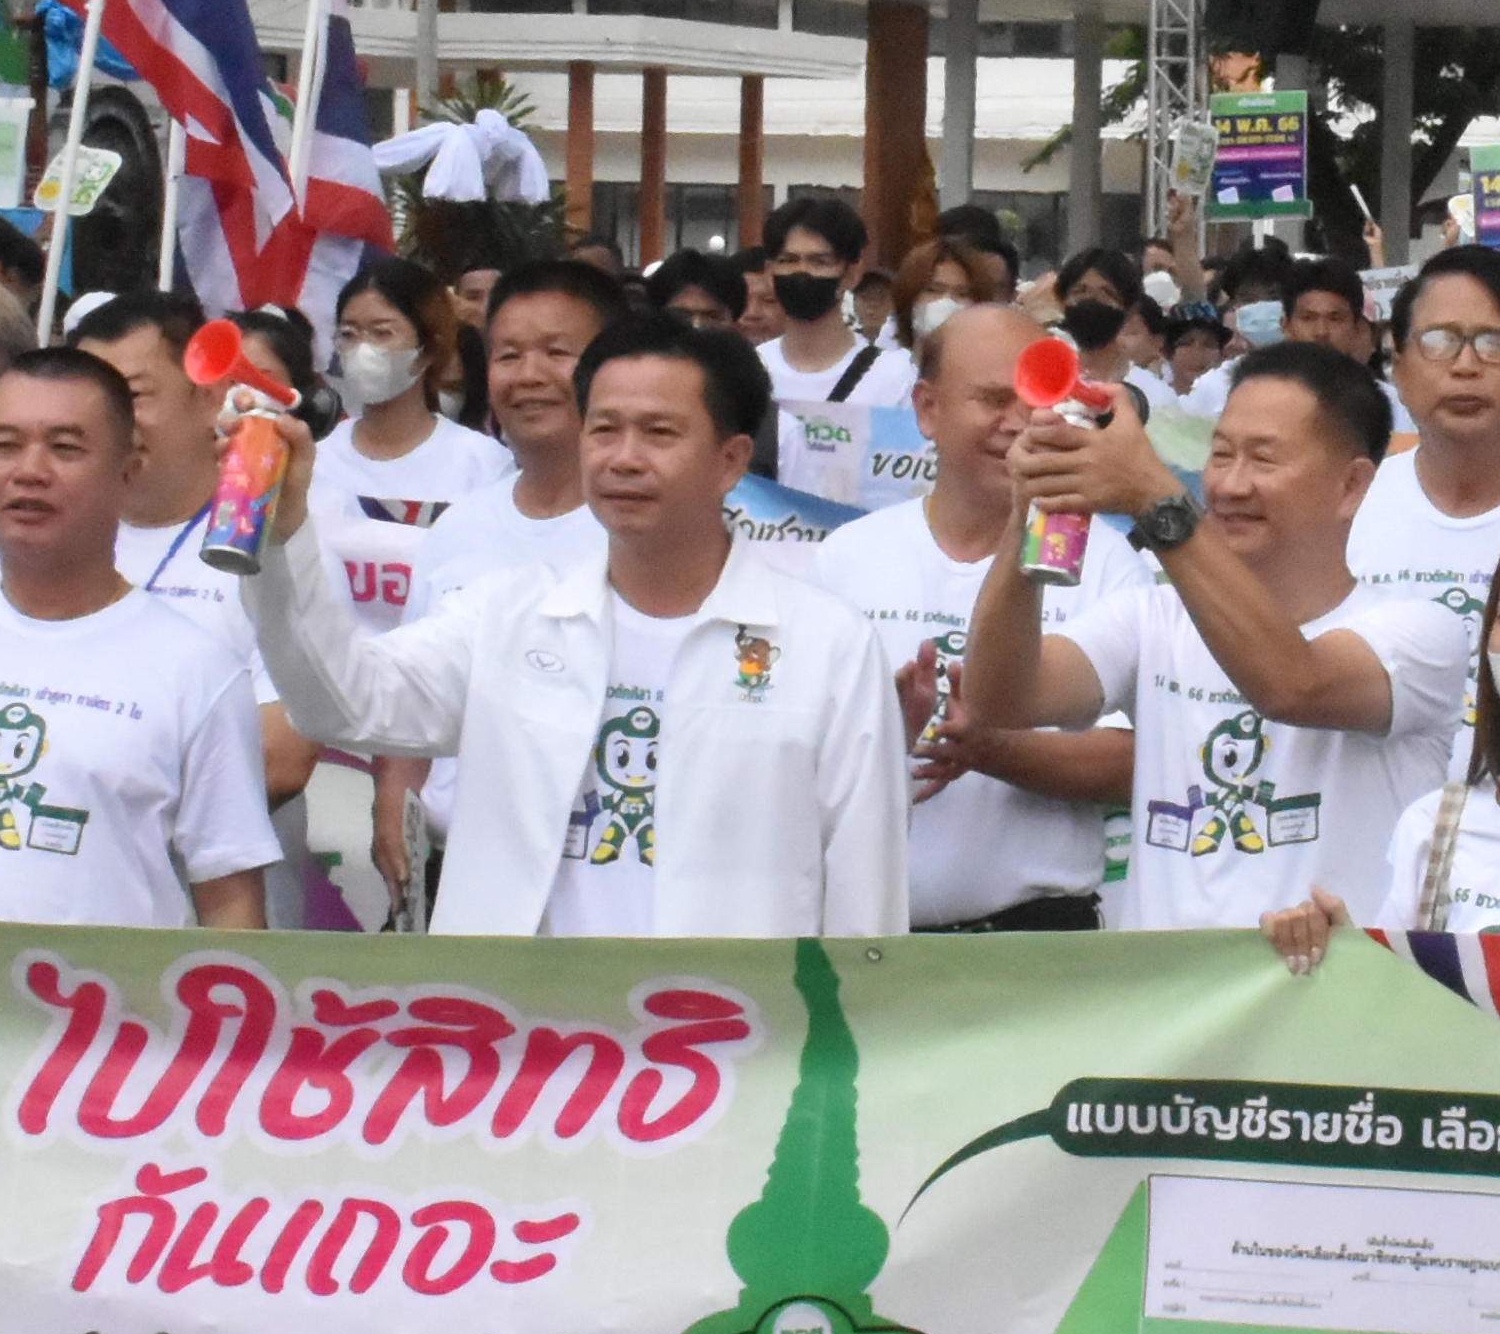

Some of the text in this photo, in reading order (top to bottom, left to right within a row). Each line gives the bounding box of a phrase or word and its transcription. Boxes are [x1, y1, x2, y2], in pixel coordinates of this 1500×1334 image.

[1278, 115, 1299, 132] 66
[115, 702, 125, 716] 2
[1454, 887, 1472, 903] 66
[17, 960, 751, 1144] ไปใช้สิทธิ
[1066, 1091, 1404, 1149] แบบบัญชีรายชื่อ
[70, 1161, 581, 1297] กันเถอะ
